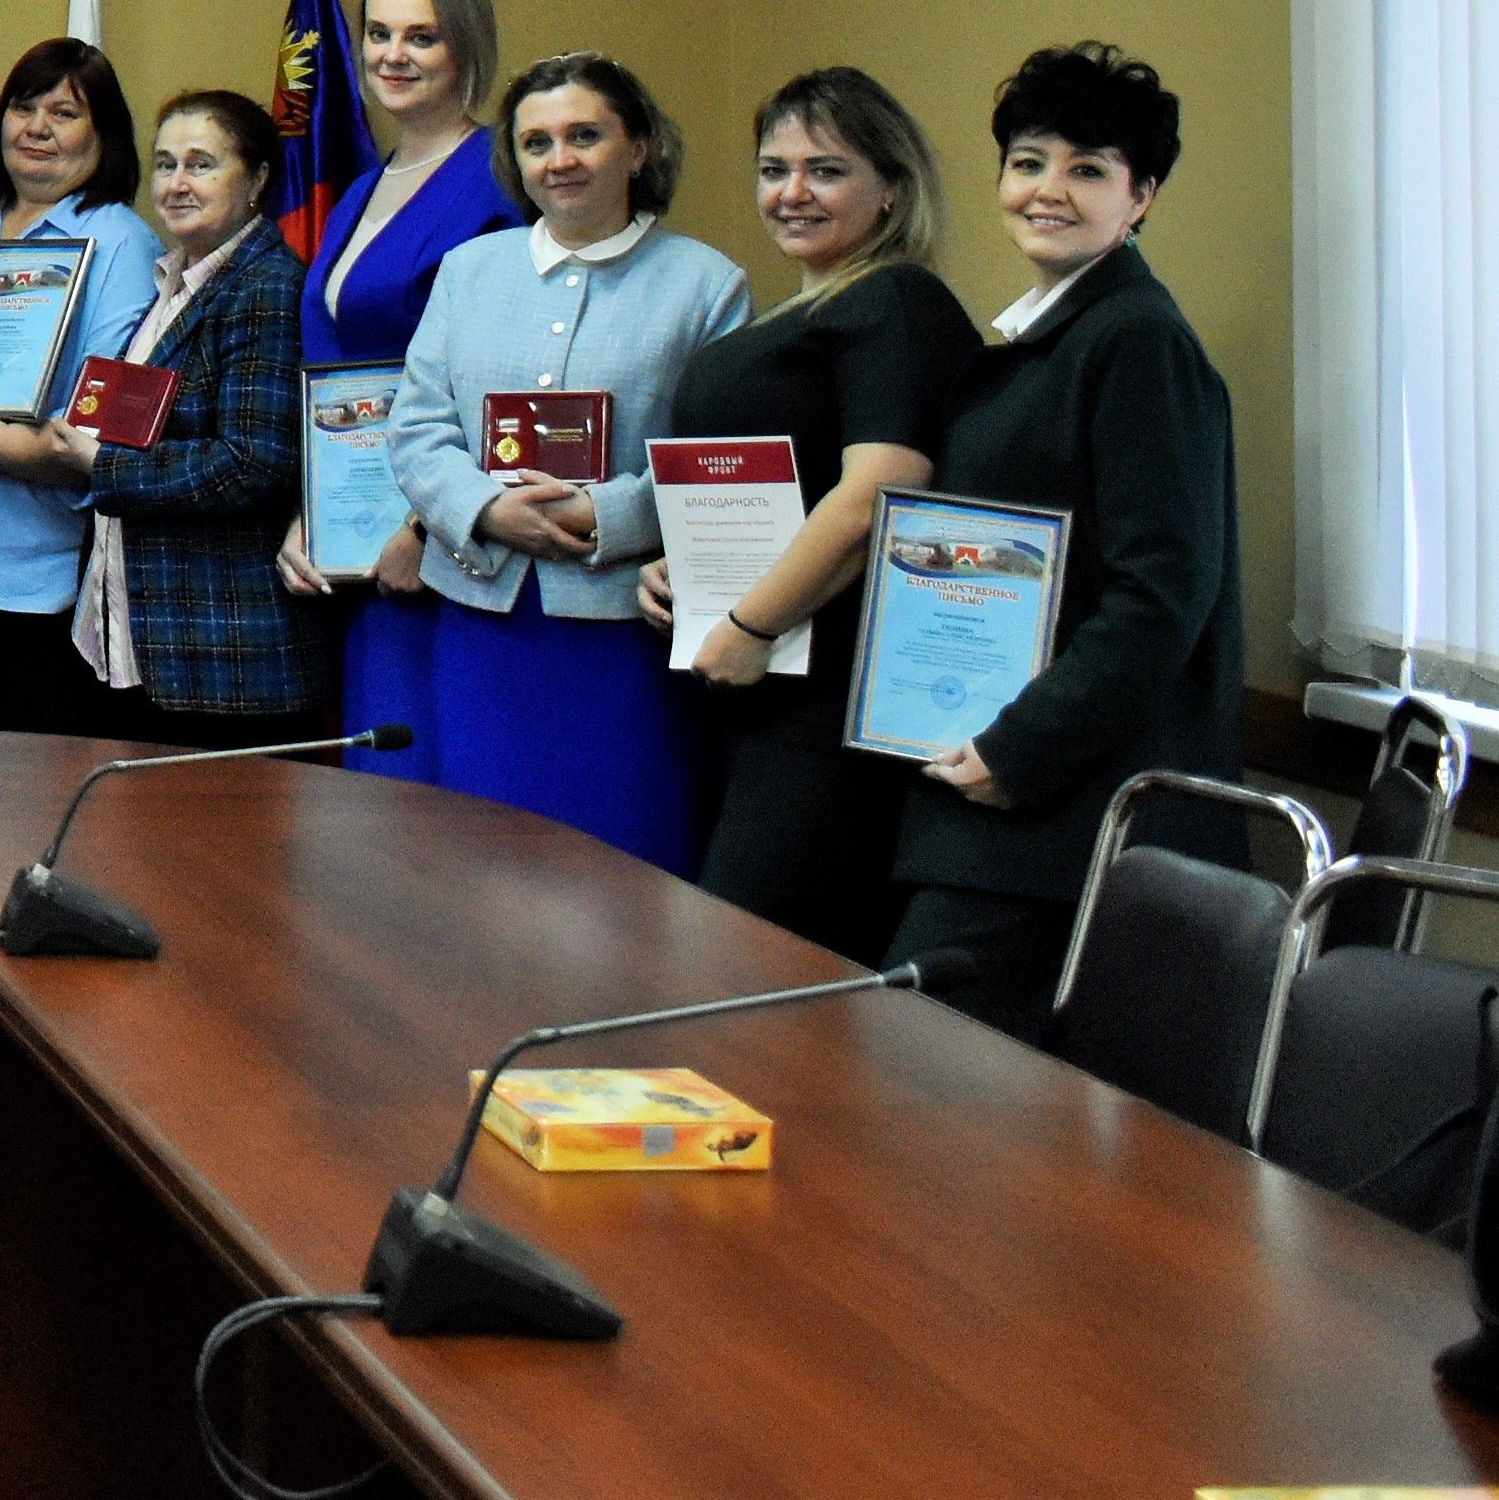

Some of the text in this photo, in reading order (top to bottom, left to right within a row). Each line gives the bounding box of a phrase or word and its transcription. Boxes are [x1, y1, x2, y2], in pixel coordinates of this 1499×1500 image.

[684, 497, 770, 508] БЛАГОДАРНОСТЬ
[906, 576, 1020, 600] БЛАГОДАРСТВЕННОЕ
[938, 592, 985, 606] ПИСЬМО
